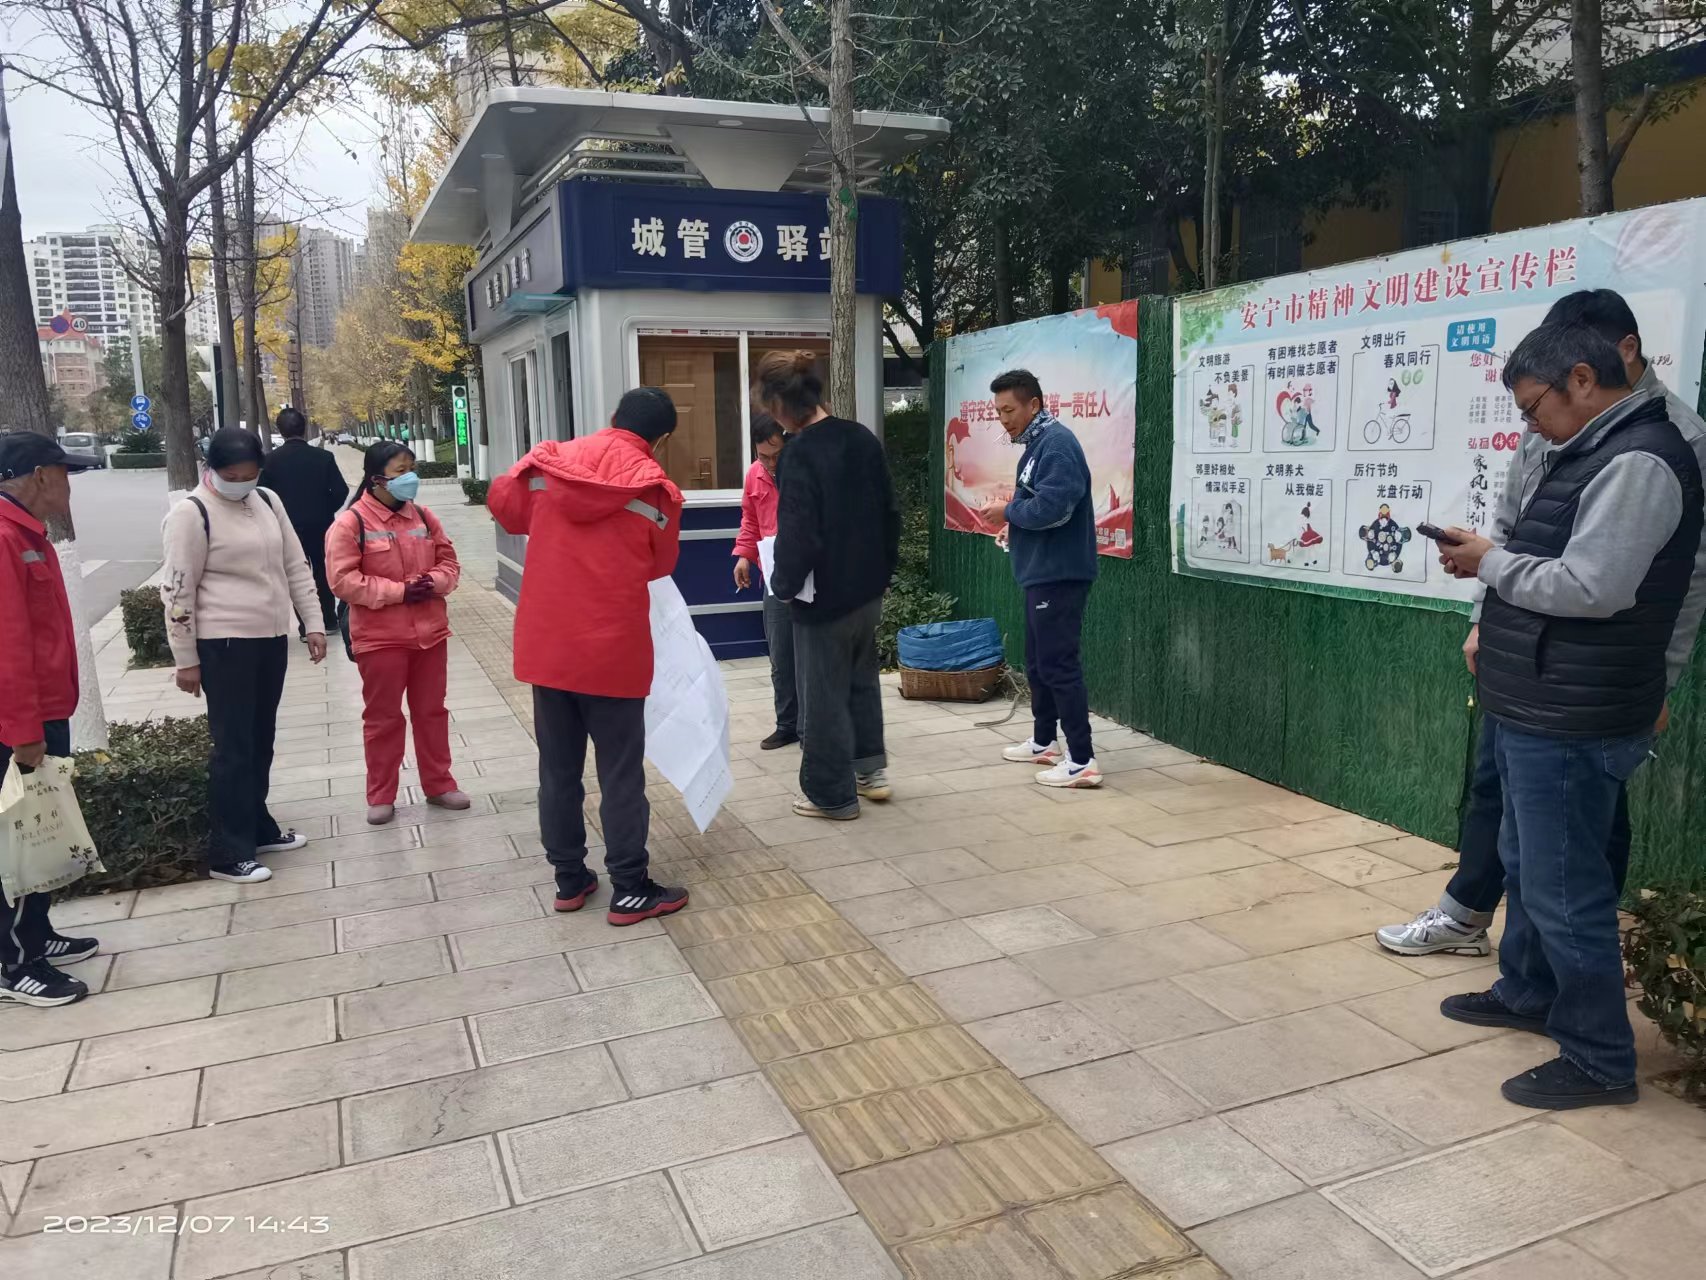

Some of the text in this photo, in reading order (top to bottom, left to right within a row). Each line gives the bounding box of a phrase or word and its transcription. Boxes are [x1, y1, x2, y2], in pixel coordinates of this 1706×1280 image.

[632, 216, 710, 259] 城管
[1239, 246, 1577, 331] 安宁市精神文明建设宣传栏
[73, 320, 85, 329] 40
[1456, 322, 1486, 335] 请使用
[1360, 330, 1406, 350] 文明出行
[1451, 333, 1490, 348] 文明用语
[1267, 340, 1338, 361] 有困难找志愿者
[1198, 353, 1231, 368] 文明旅游
[1383, 350, 1431, 368] 春风同行
[1214, 369, 1249, 384] 不负美景
[1267, 360, 1337, 380] 有时间做志愿者
[960, 399, 1001, 424] 遵守安全
[1195, 463, 1236, 476] 邻里好相处
[1266, 463, 1305, 477] 文明养犬
[1354, 462, 1398, 478] 厉行节约
[1205, 481, 1246, 494] 情深似手足
[1285, 482, 1324, 497] 从我做起
[1376, 484, 1423, 499] 光盘行动
[1470, 453, 1488, 528] 家风家训
